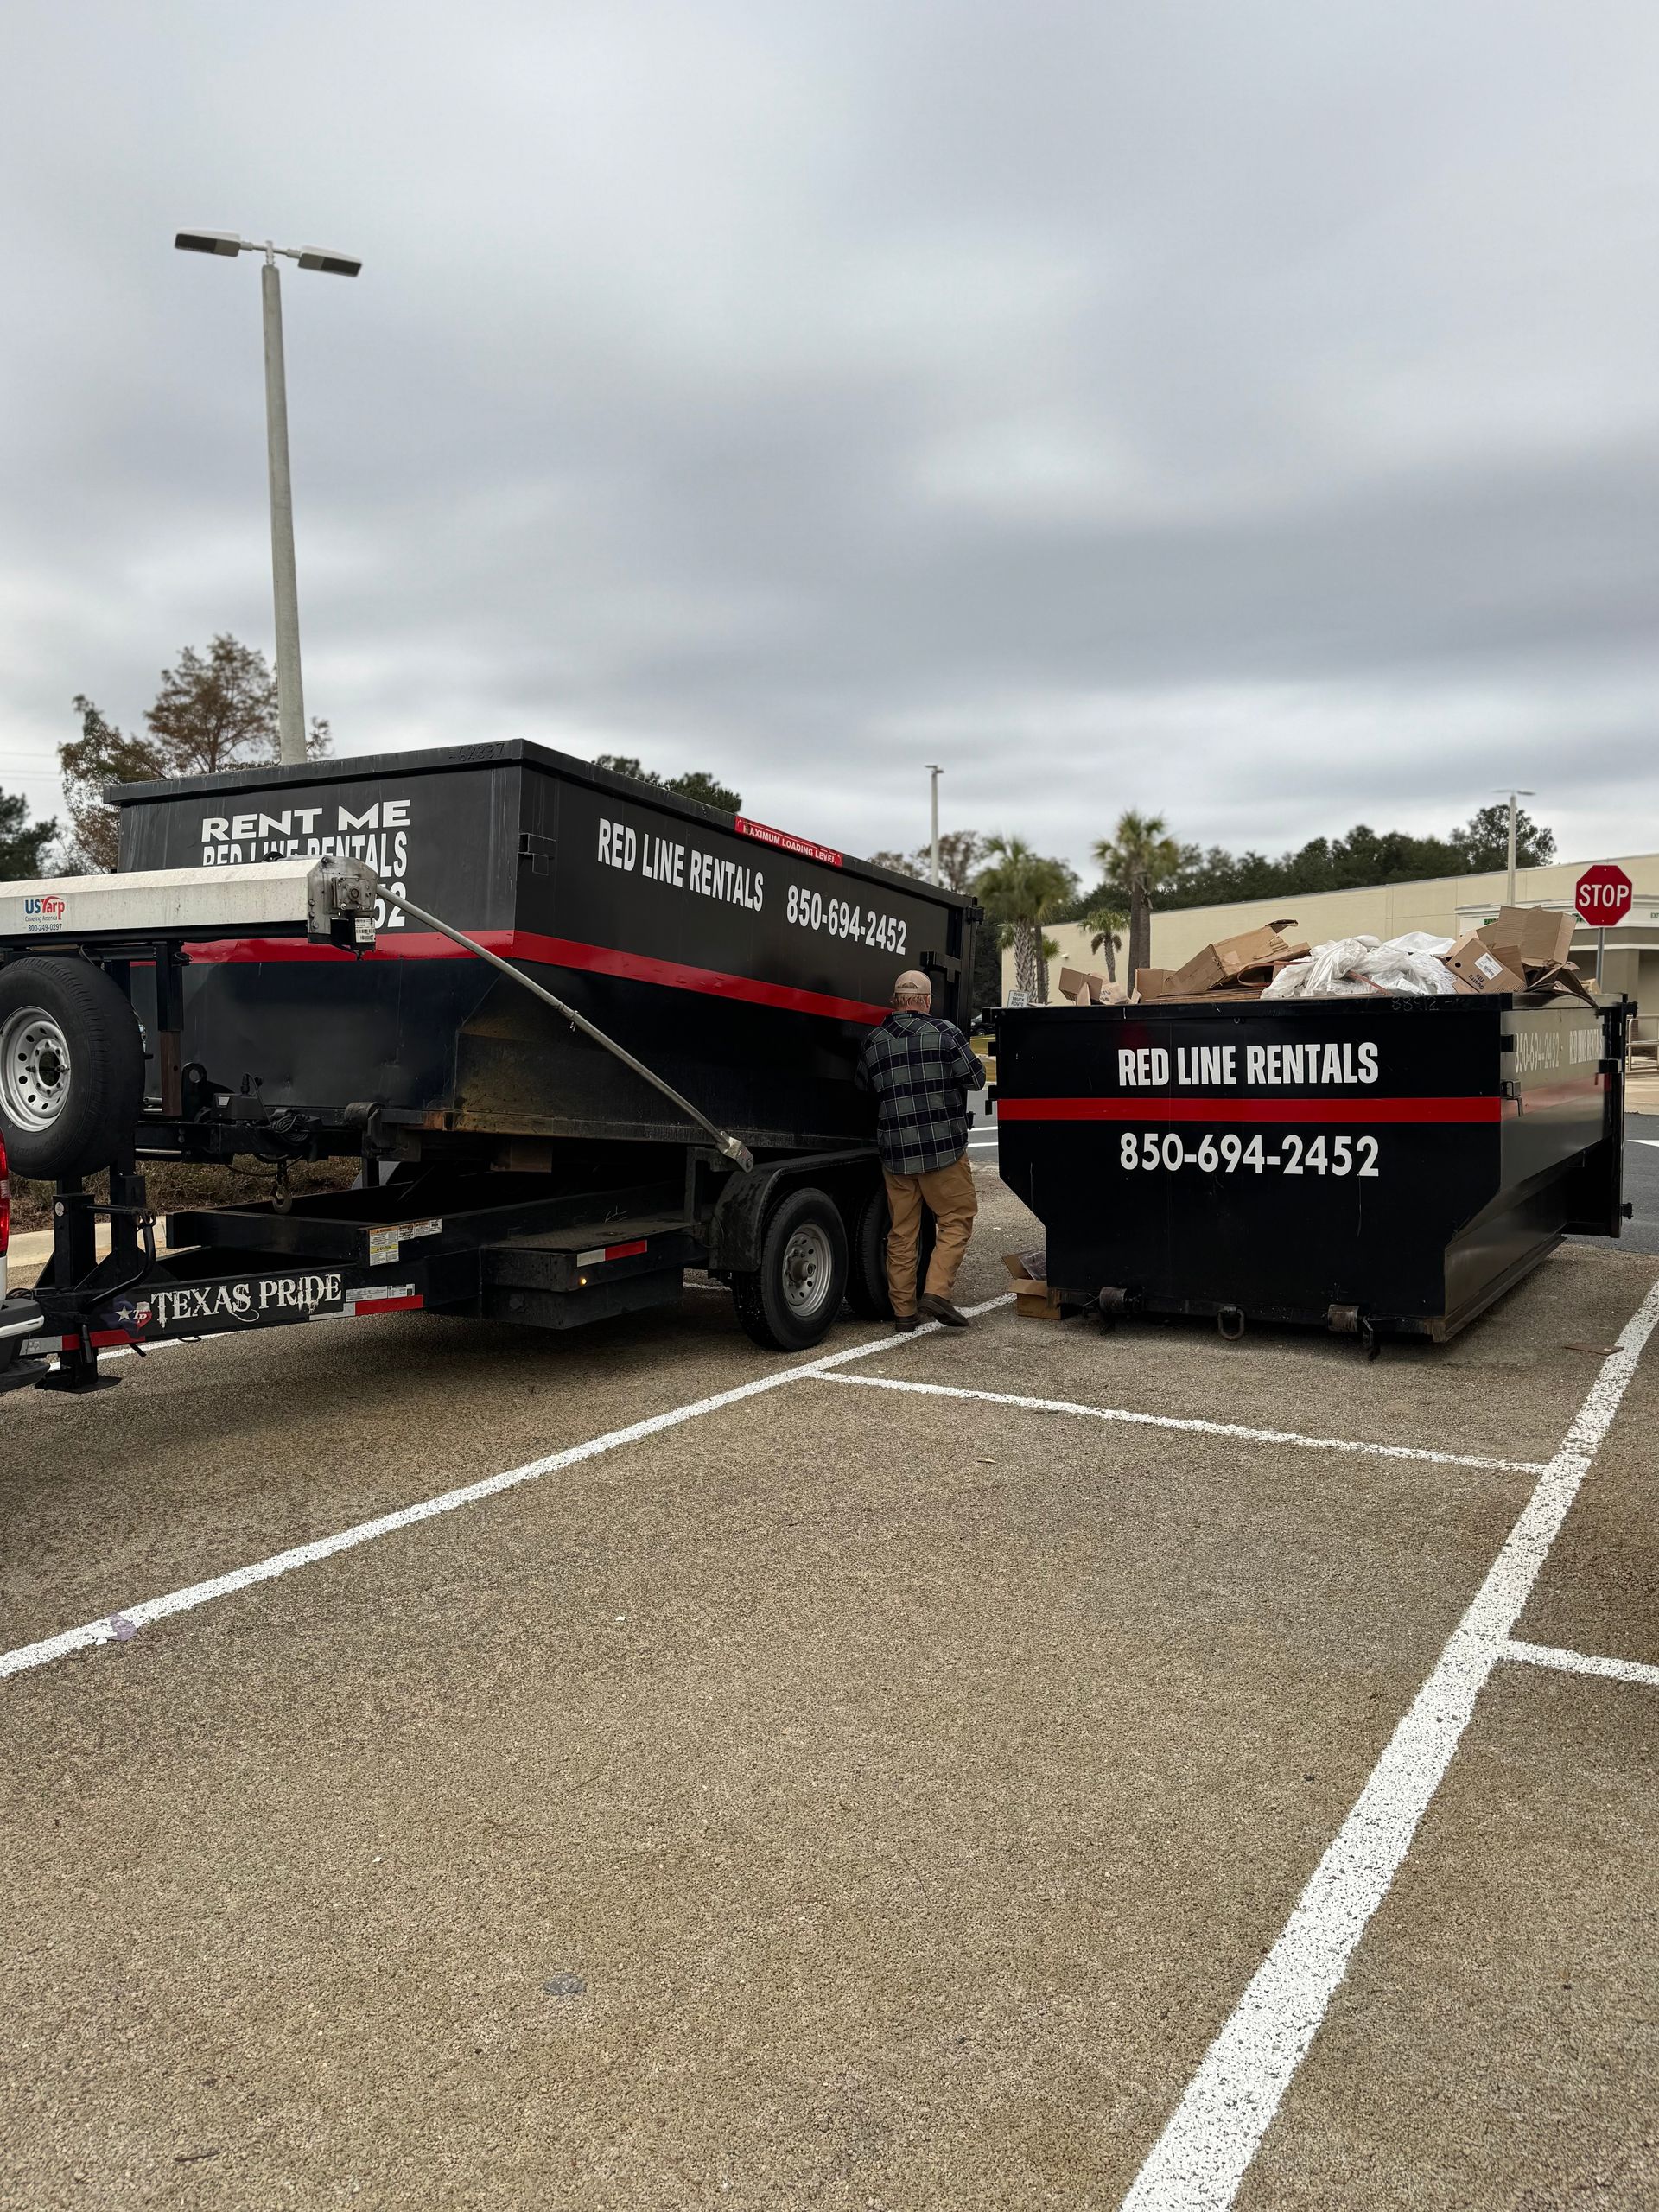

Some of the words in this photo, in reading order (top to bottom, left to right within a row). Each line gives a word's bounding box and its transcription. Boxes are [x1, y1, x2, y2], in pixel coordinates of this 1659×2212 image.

[201, 807, 322, 842] RENT
[338, 799, 410, 831] ME
[782, 838, 813, 856] LOADING
[815, 850, 836, 863] LEVEL
[598, 817, 637, 872] RED
[642, 833, 685, 887] LINE
[690, 849, 764, 912] RENTALS
[786, 884, 906, 956] 850-694-2452
[1579, 884, 1630, 907] STOP
[1118, 1047, 1169, 1086] RED
[1177, 1046, 1236, 1085] LINE
[1246, 1041, 1379, 1084] RENTALS
[1120, 1132, 1379, 1177] 850-694-2452
[150, 1283, 259, 1329] TEXAS
[259, 1273, 342, 1315] PRIDE
